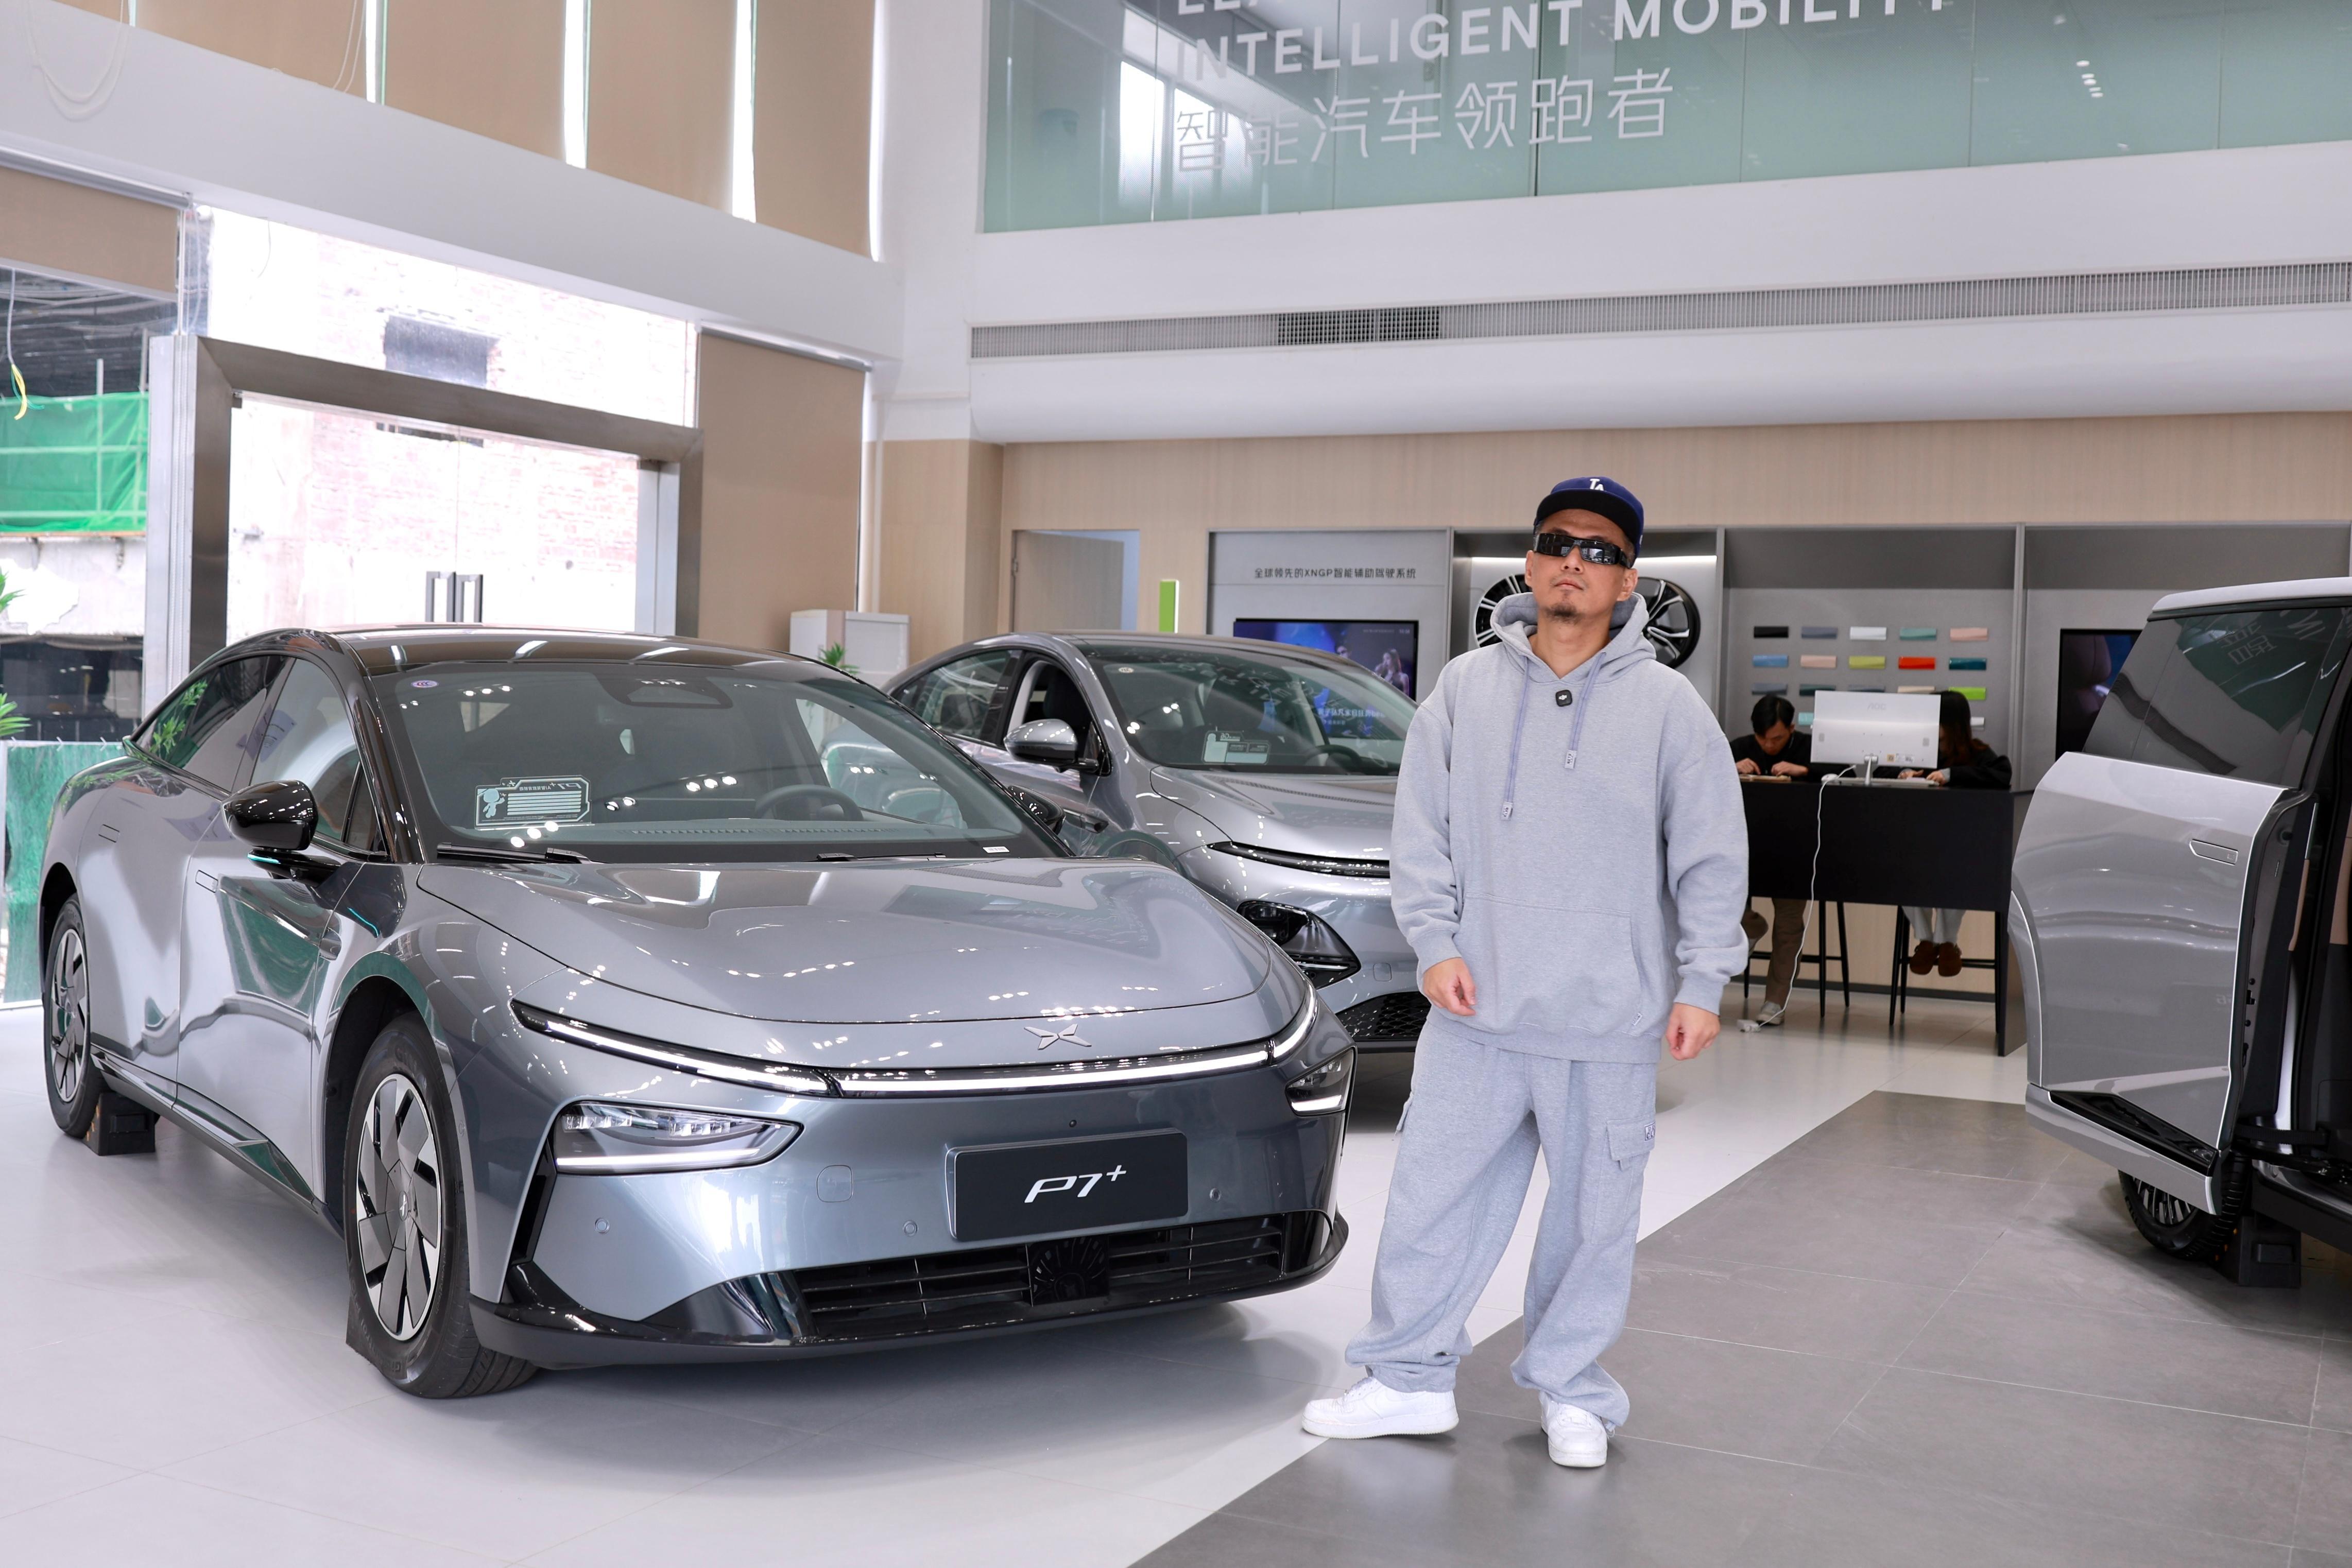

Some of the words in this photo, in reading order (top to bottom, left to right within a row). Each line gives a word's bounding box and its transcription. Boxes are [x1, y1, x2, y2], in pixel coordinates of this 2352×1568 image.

[1176, 0, 1583, 81] INTELLIGENT
[1614, 0, 1943, 41] MOBIL
[1176, 67, 1674, 173] 智能汽车领跑者
[1255, 567, 1416, 579] 全球领先的XNGP智能辅助驾驶系统
[1024, 1165, 1127, 1203] P7+
